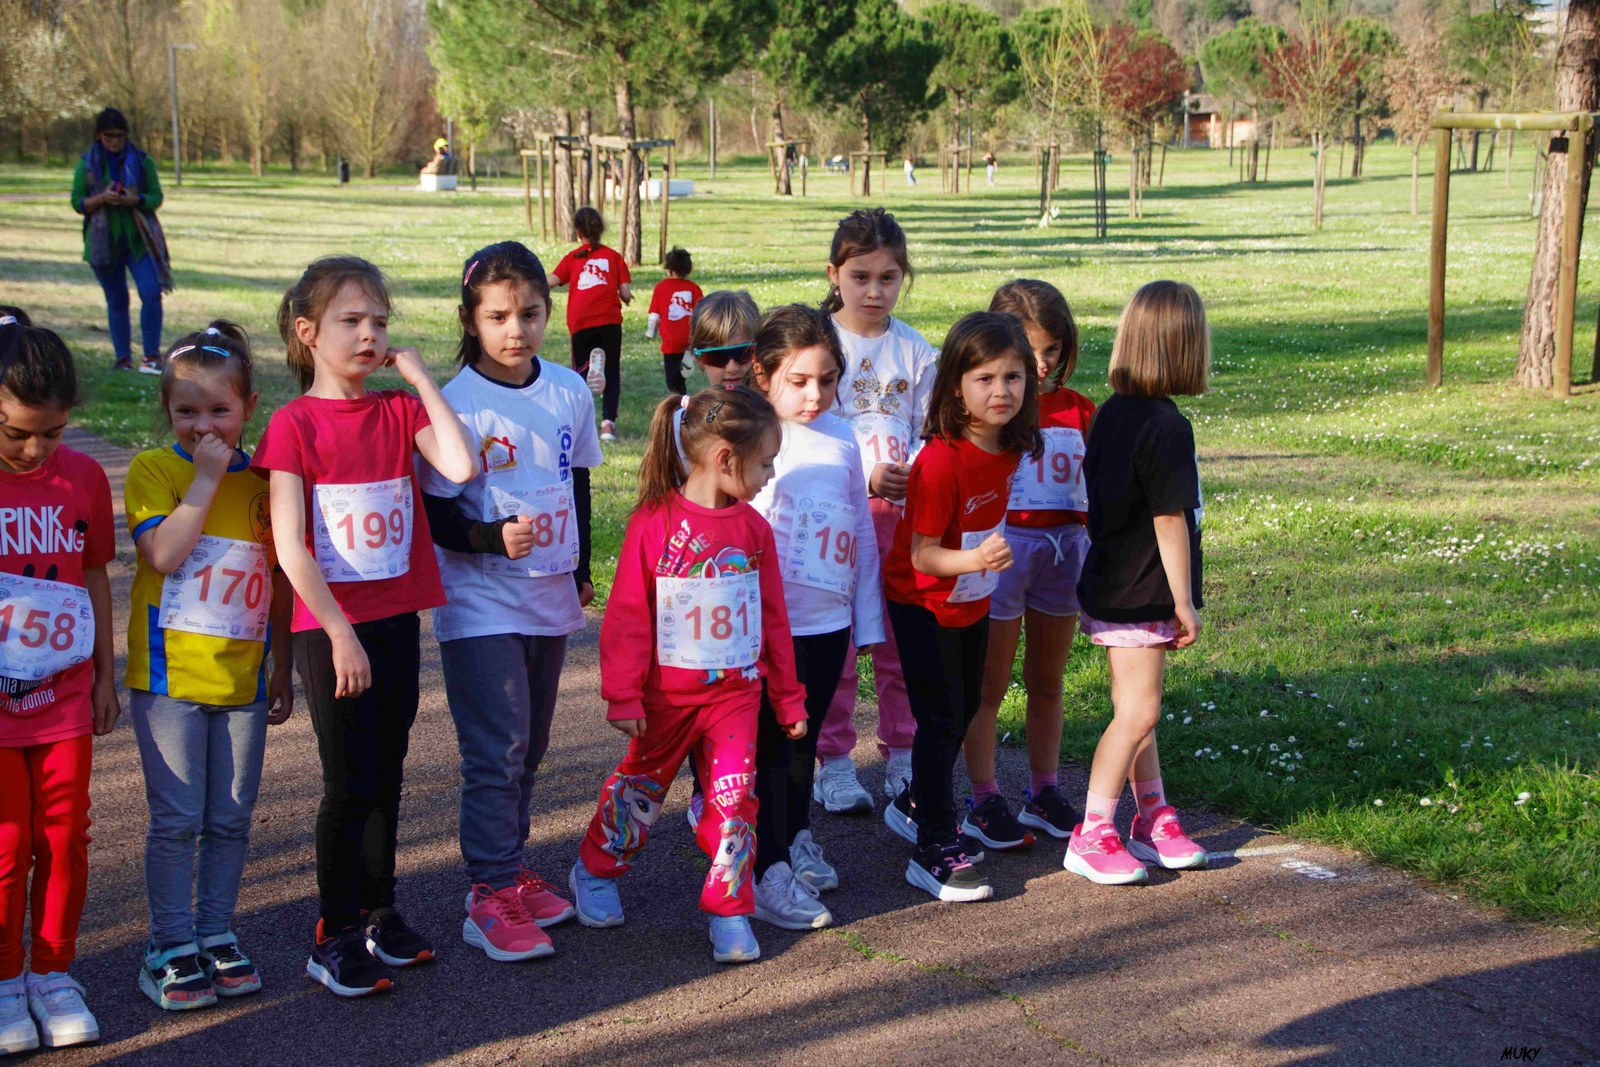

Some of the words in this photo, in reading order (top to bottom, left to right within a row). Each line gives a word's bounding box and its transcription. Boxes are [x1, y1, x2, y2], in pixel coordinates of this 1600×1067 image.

[1029, 452, 1085, 485] 197
[0, 506, 64, 530] PINK
[337, 508, 404, 550] 199
[534, 509, 568, 548] 87
[0, 528, 85, 555] NNING
[814, 526, 857, 569] 190
[193, 564, 263, 610] 170
[0, 604, 76, 651] 158
[685, 602, 748, 641] 181
[0, 677, 18, 693] lla
[22, 688, 55, 711] donne
